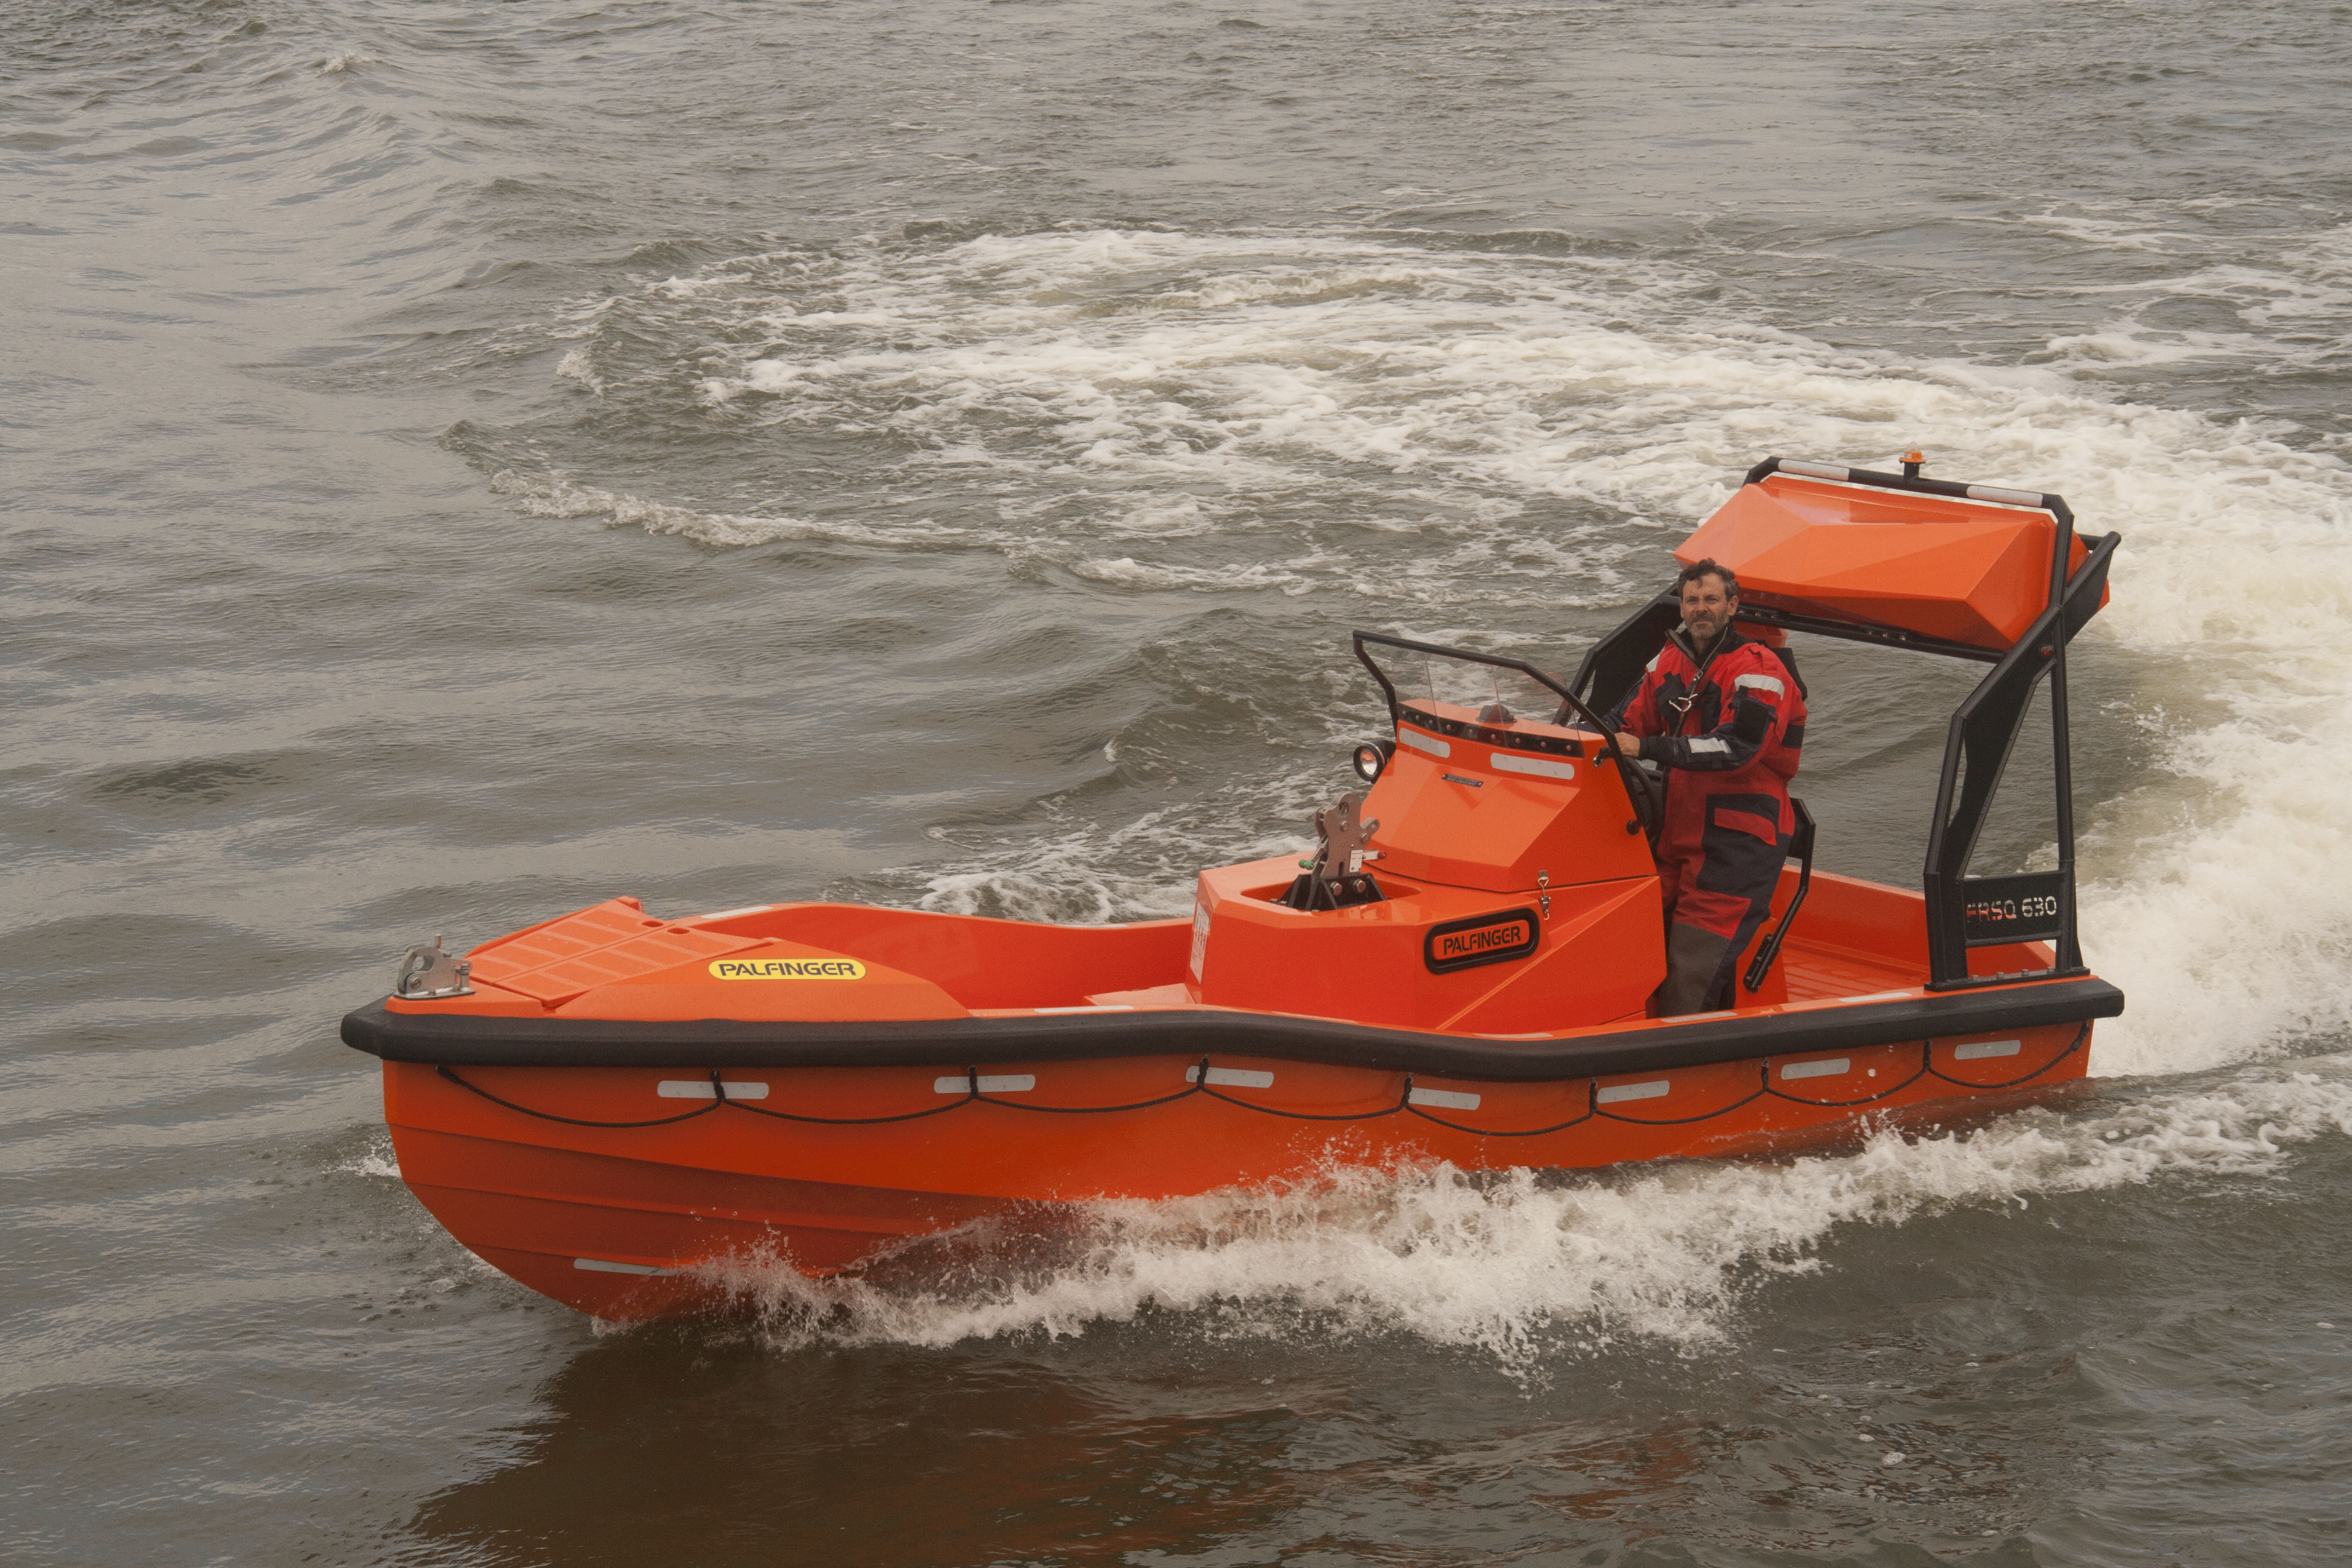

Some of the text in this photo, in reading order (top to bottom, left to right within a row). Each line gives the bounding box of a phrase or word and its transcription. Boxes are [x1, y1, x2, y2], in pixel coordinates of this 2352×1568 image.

[1967, 896, 2057, 923] FRSQ 630
[1444, 926, 1521, 955] PALFINGER
[719, 963, 856, 976] PALFINGER
